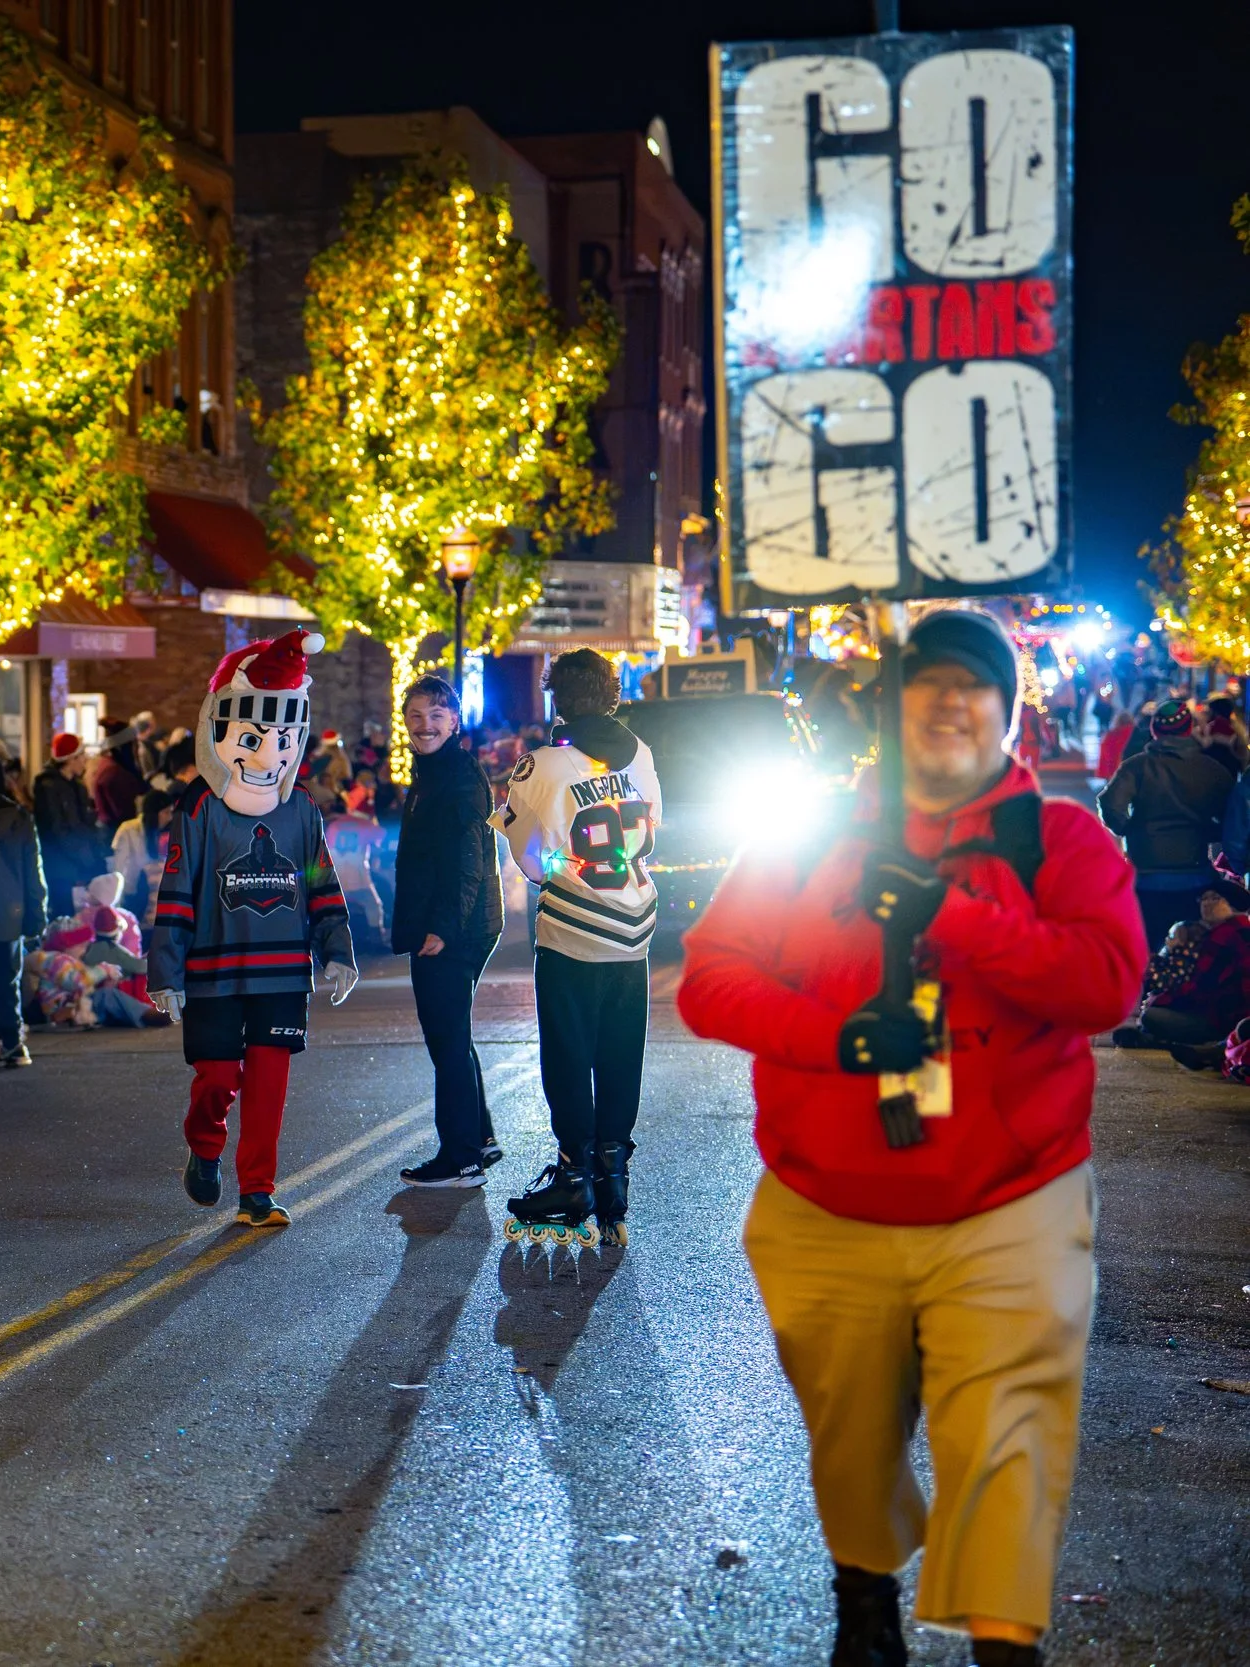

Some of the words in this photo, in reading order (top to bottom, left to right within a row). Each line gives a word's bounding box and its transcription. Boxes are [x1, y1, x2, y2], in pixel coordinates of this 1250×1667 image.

[735, 48, 1056, 282] GO
[743, 278, 1057, 368] RTANS
[742, 360, 1058, 595] GO
[569, 772, 632, 808] INGRAM
[569, 800, 655, 891] 97
[225, 873, 297, 892] SPARTANS
[270, 1026, 305, 1036] CCM
[459, 1163, 480, 1176] HOKA
